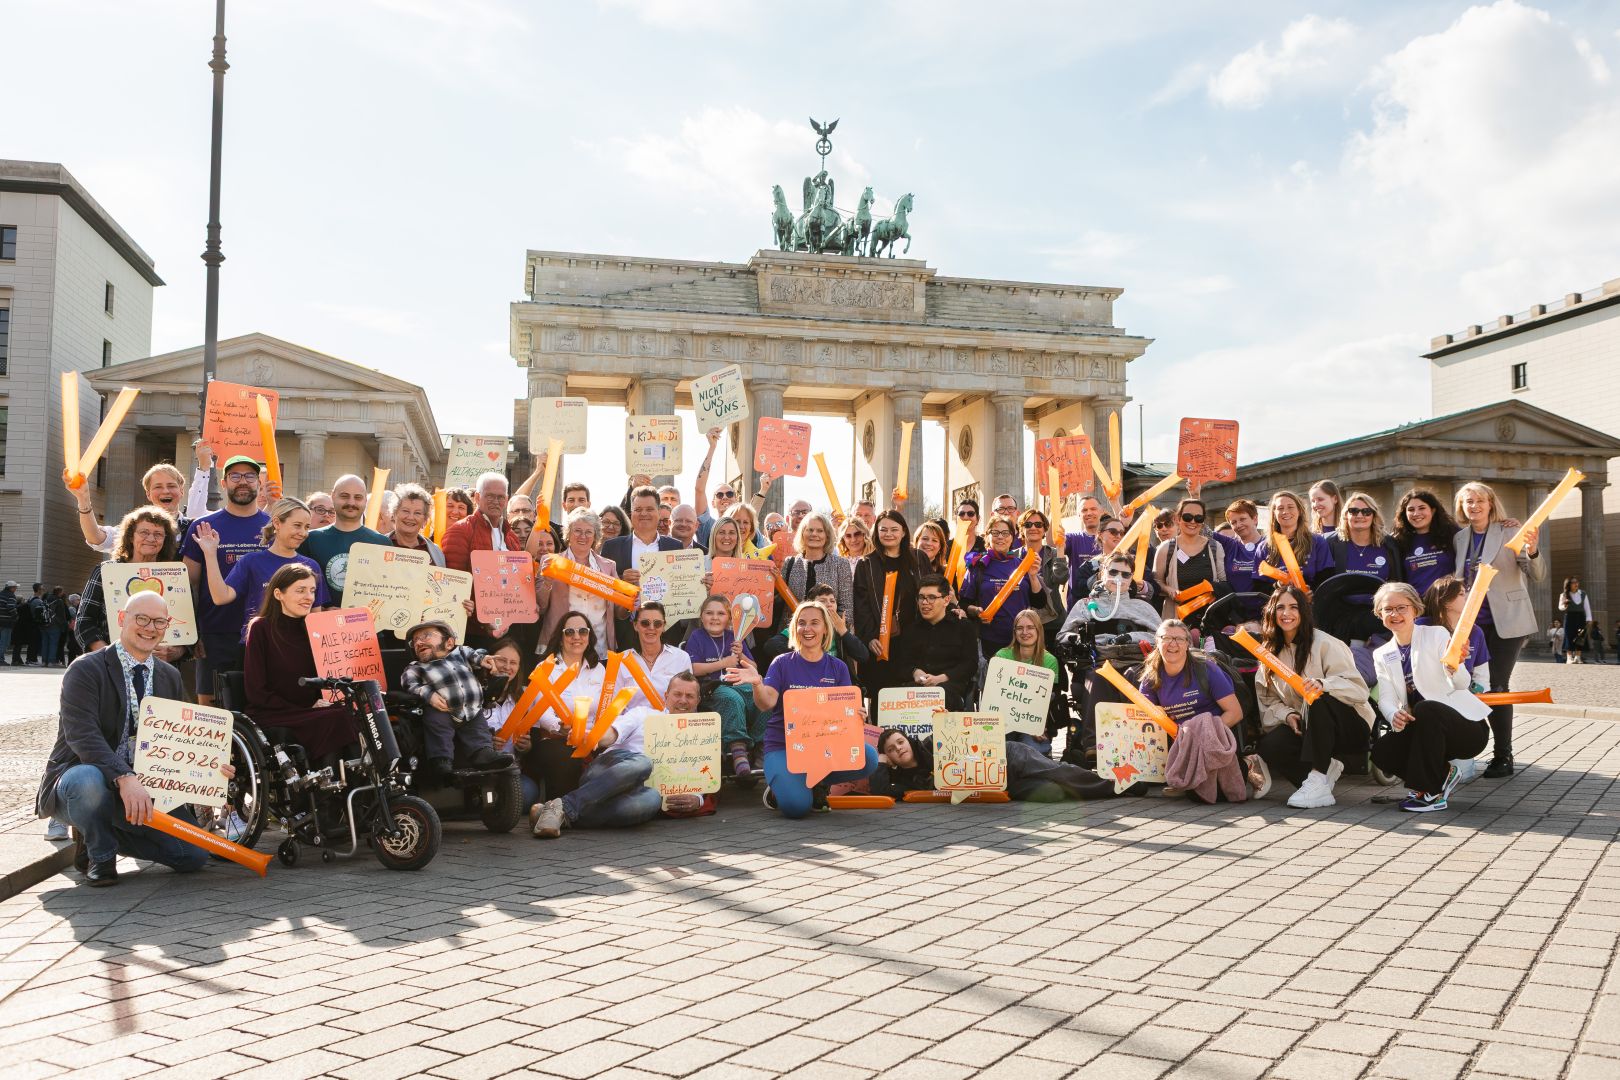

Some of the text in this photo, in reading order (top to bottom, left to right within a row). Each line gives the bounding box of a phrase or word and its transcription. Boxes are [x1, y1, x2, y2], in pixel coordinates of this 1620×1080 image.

[699, 383, 723, 402] NICHT
[702, 396, 724, 411] UNS
[715, 400, 739, 417] UNS
[456, 448, 484, 457] Danke
[321, 633, 340, 648] ALLE
[323, 647, 377, 666] ALLE RECHTE.
[346, 664, 382, 678] CHANCEN.
[1008, 676, 1028, 689] Kein
[1000, 688, 1032, 704] Fehler
[989, 704, 1042, 722] im System
[194, 716, 227, 726] Kinderhospiz
[143, 716, 226, 742] GEMEINSAM
[151, 732, 174, 742] geht
[650, 733, 671, 754] Jeder
[673, 733, 698, 748] Schritt
[146, 745, 219, 770] 25.09.26
[679, 752, 712, 767] langsam
[149, 764, 181, 776] Etappe
[660, 783, 702, 795] Pusteblume
